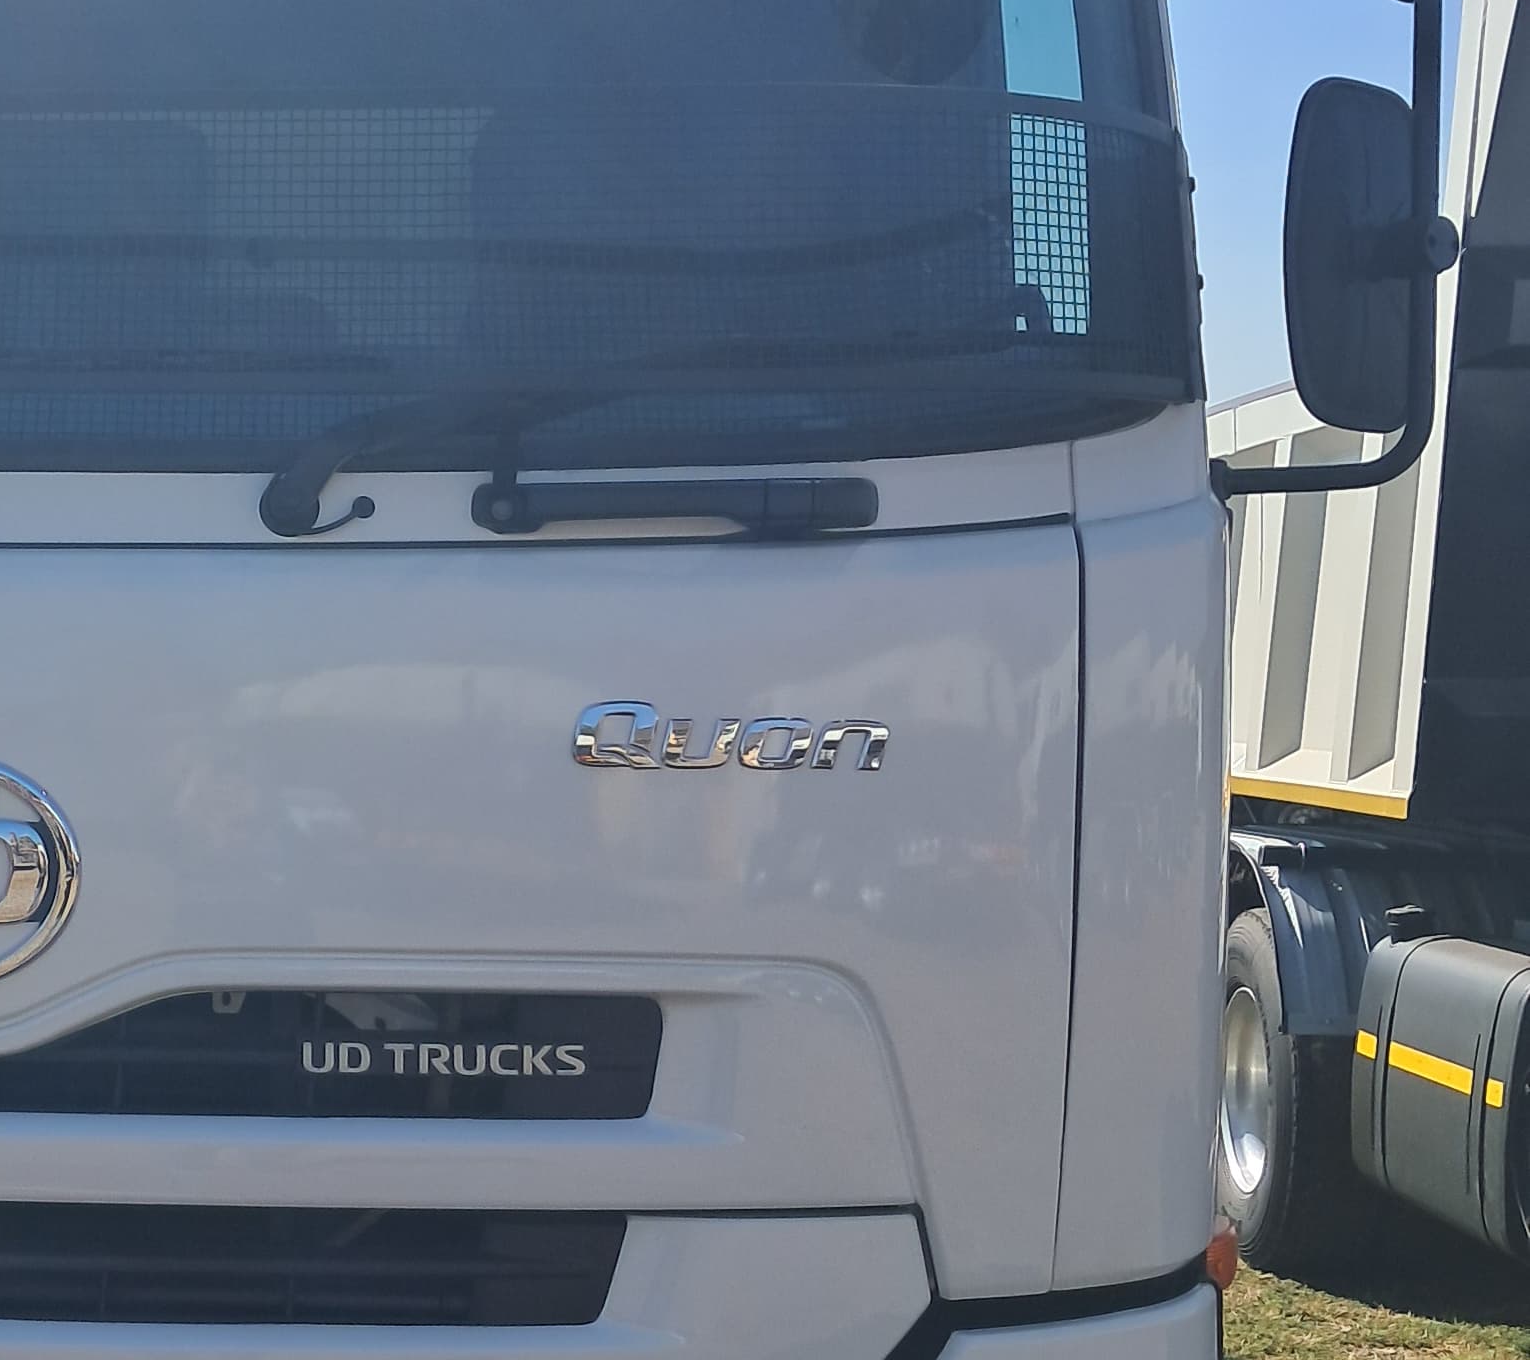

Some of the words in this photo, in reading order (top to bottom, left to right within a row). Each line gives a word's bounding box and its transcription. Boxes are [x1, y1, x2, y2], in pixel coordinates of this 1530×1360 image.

[573, 700, 891, 771] Quon
[302, 1041, 370, 1073] UD
[383, 1043, 586, 1076] TRUCKS
